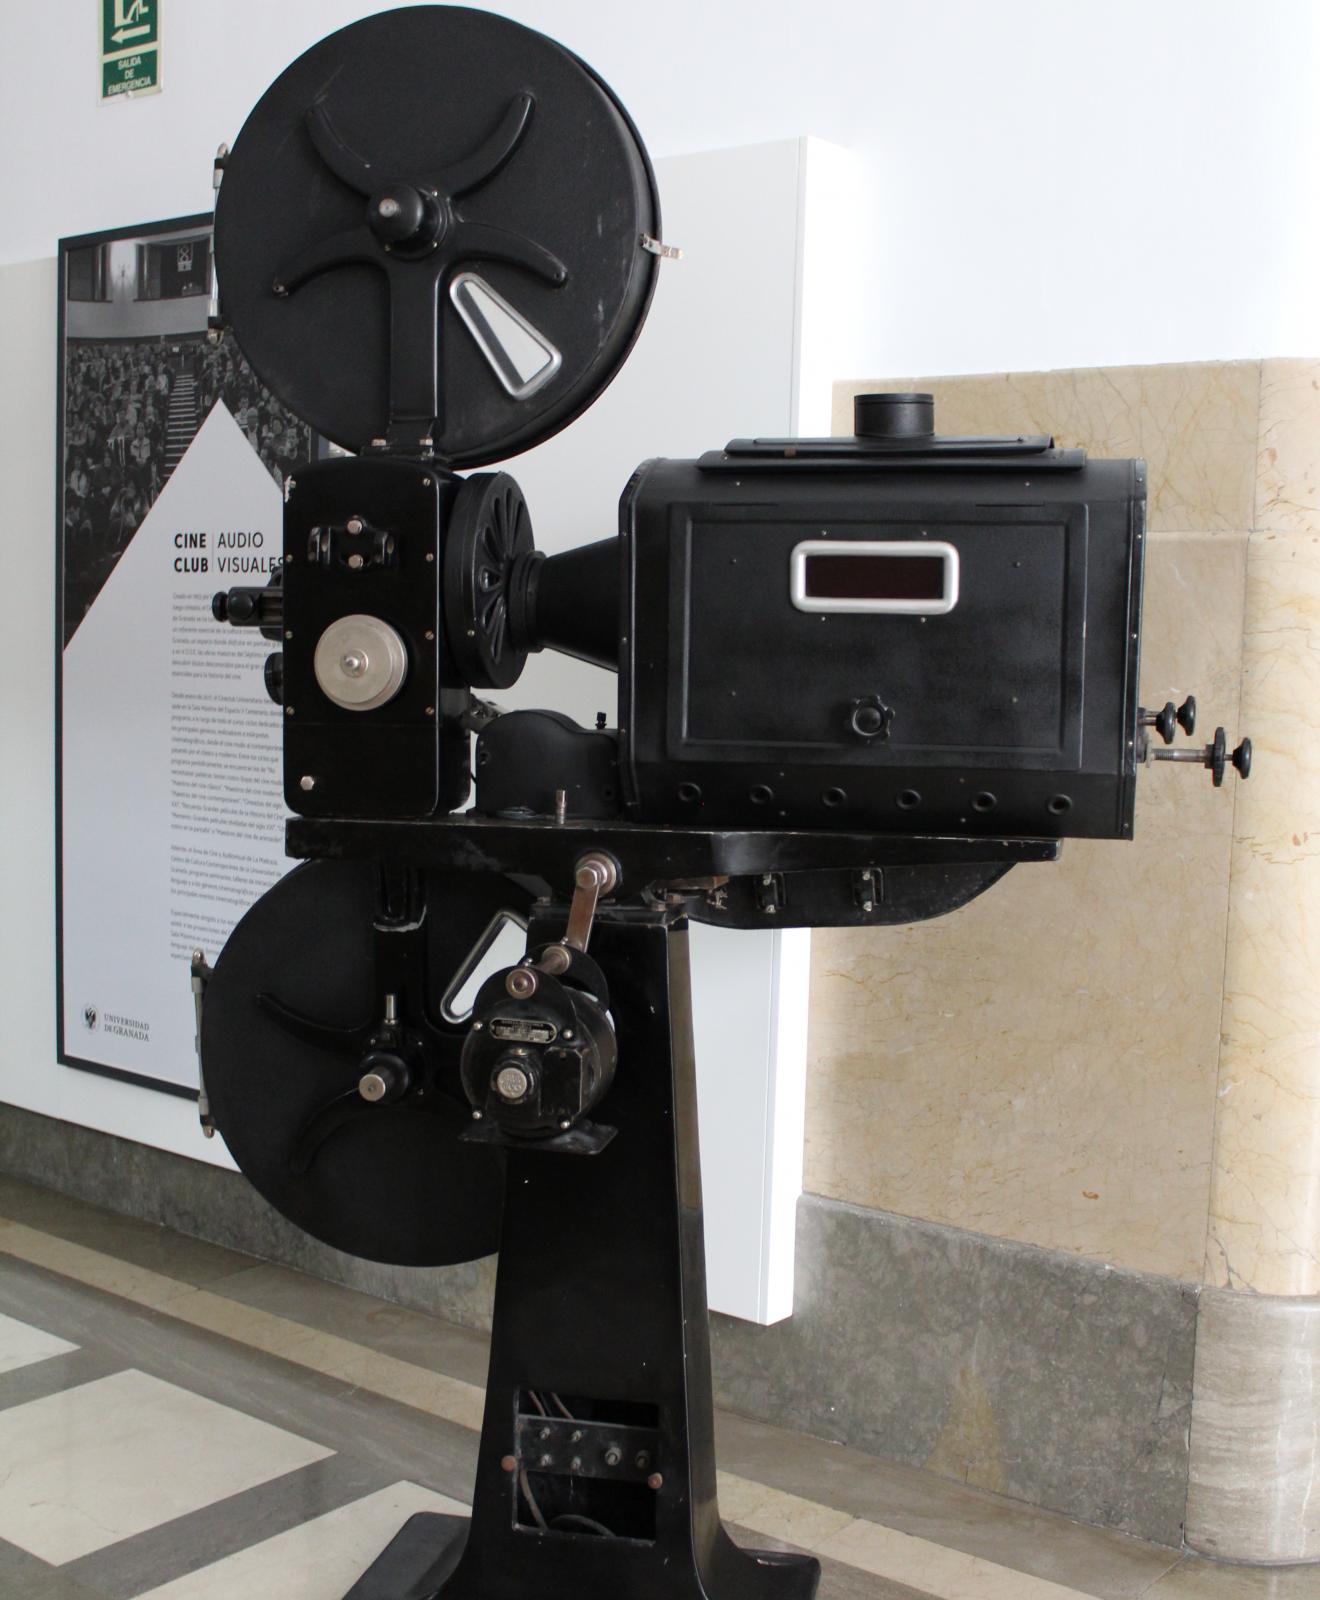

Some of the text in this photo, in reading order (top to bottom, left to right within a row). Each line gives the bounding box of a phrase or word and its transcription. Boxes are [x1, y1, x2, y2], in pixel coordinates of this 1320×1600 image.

[118, 56, 141, 70] SALIDA
[124, 68, 135, 80] DE
[108, 76, 151, 95] EMERGENCIA
[174, 533, 206, 548] CINE
[218, 532, 264, 548] AUDIO
[174, 557, 208, 573] CLUB
[104, 1013, 149, 1031] UNIVERSIDAD
[113, 1027, 149, 1041] GRANADA
